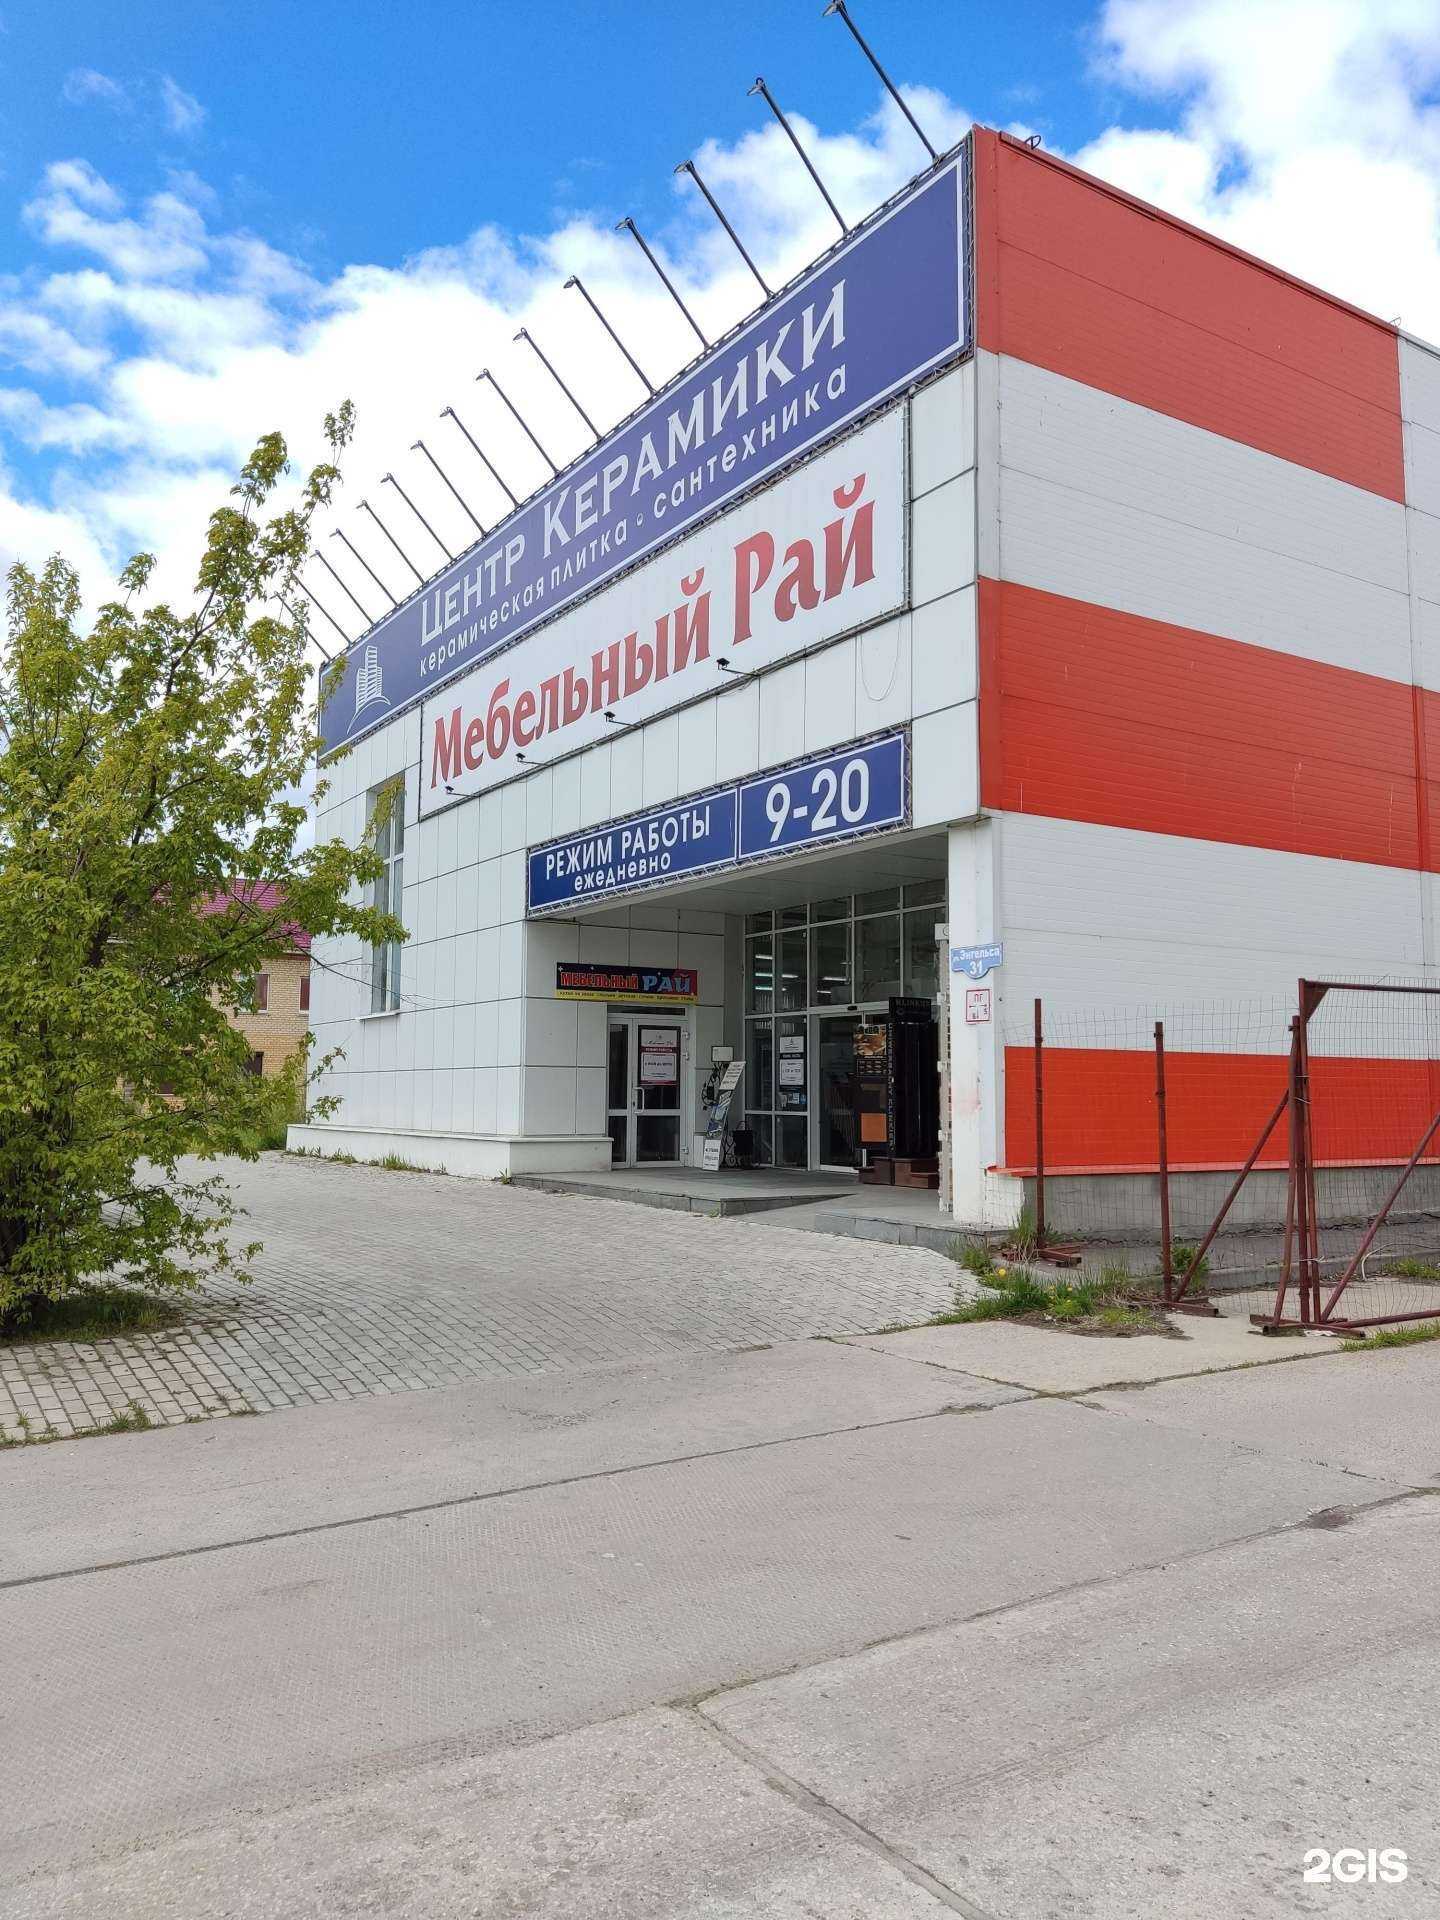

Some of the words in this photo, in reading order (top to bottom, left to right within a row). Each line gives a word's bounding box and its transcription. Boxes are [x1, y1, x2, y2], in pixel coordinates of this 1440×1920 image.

[420, 534, 526, 647] ЦЕНТР
[543, 279, 847, 559] КЕРАМИКИ
[419, 576, 545, 678] керамическая
[551, 517, 628, 590] плитка
[653, 363, 847, 519] сантехника
[430, 567, 712, 789] Мебельный
[732, 473, 876, 646] Рай
[765, 758, 870, 843] 9-20
[546, 835, 612, 880] РЕЖИМ
[621, 806, 711, 859] РАБОТЫ
[574, 852, 672, 892] ежедневно
[560, 972, 639, 990] МЕБЕЛЬНЫЙ
[642, 973, 691, 993] РАЙ
[960, 947, 1000, 960] Энгельса
[970, 961, 983, 975] 31
